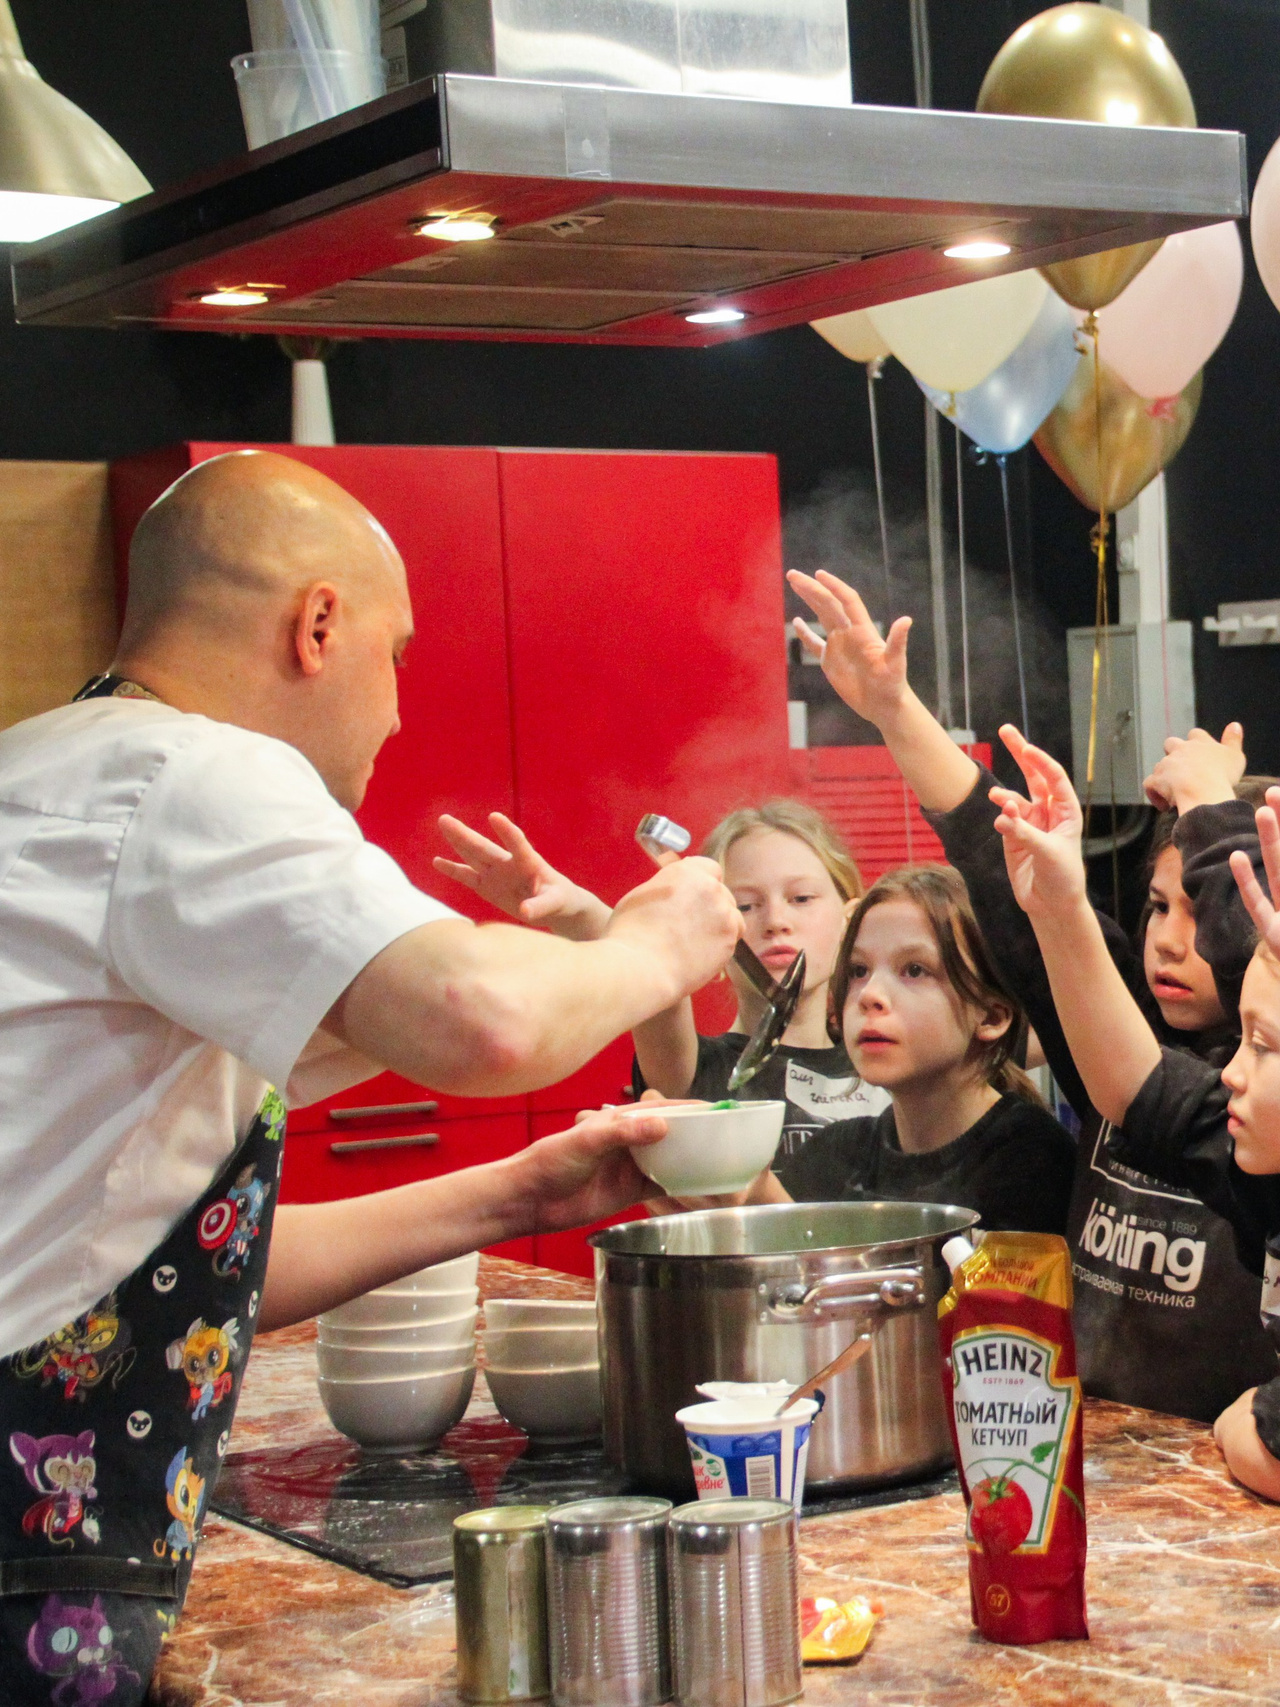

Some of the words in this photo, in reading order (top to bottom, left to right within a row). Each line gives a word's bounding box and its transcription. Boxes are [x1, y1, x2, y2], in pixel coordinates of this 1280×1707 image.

[1136, 1215, 1167, 1231] since
[1171, 1220, 1197, 1236] 1889
[1078, 1197, 1207, 1292] körting
[1128, 1285, 1196, 1308] техника
[961, 1342, 1043, 1378] HEINZ
[1005, 1378, 1024, 1386] 1869
[955, 1397, 1057, 1425] ТОМАТНЫЙ
[971, 1428, 1027, 1447] КЕТЧУП
